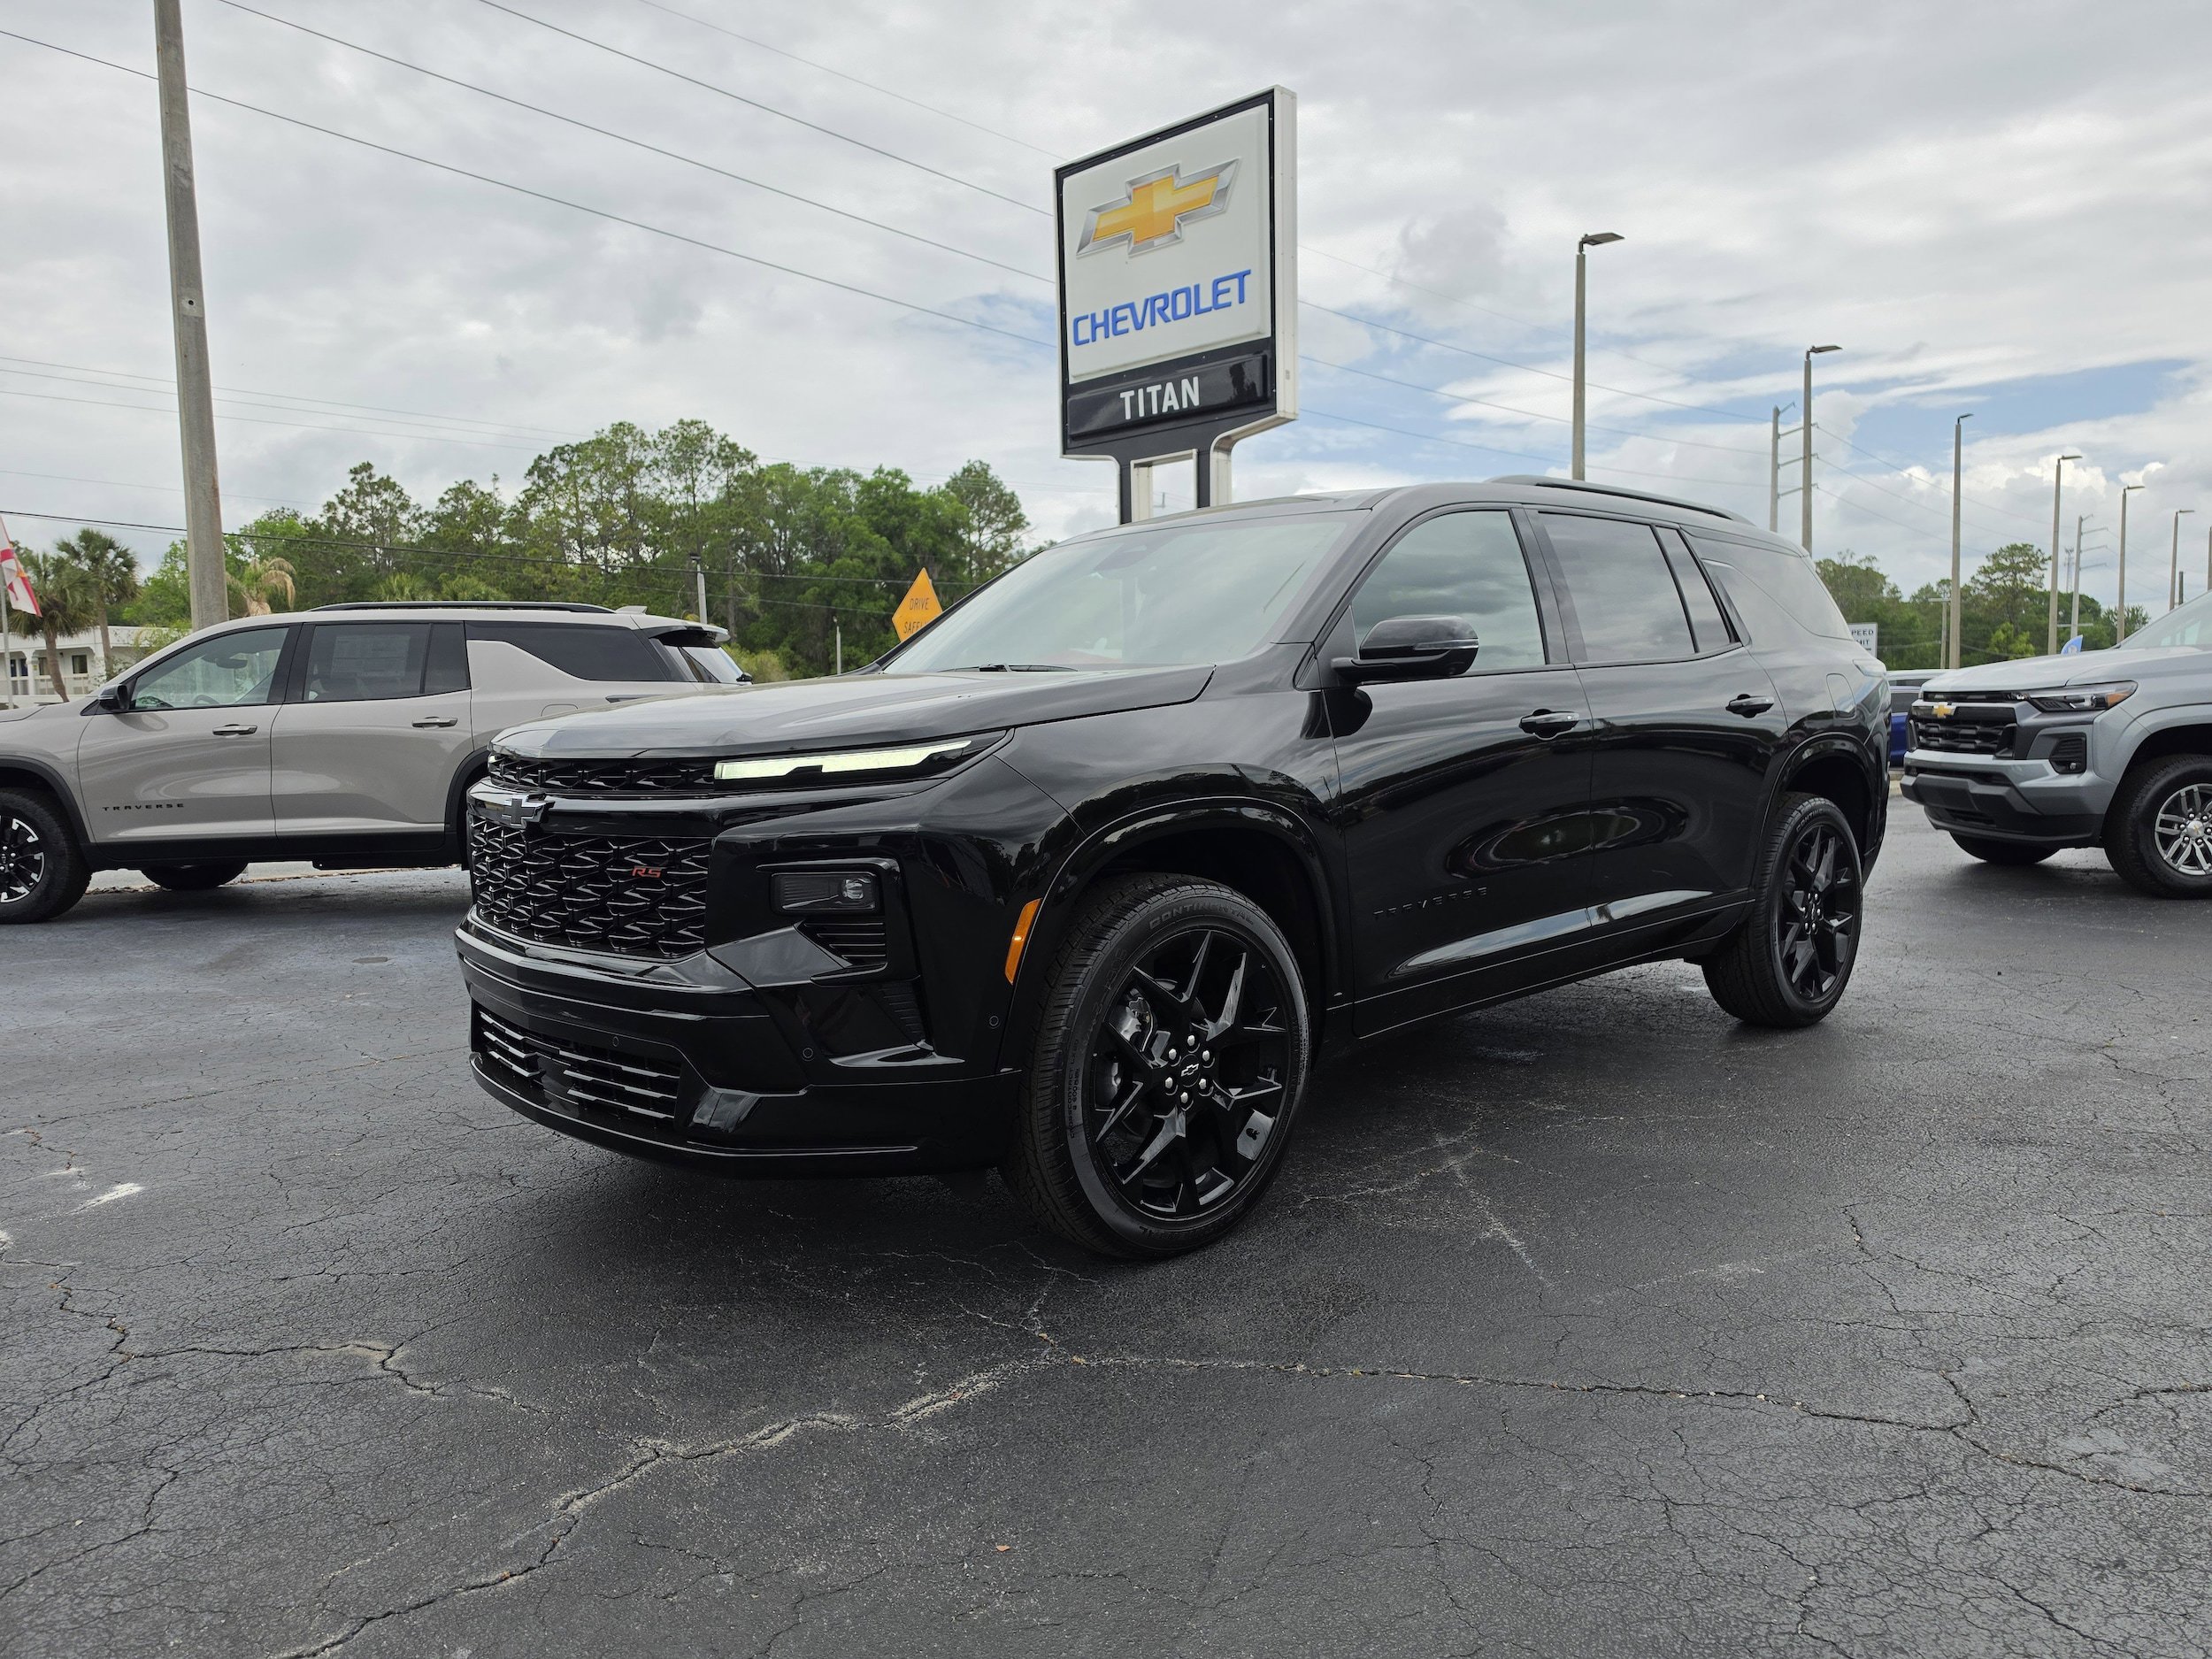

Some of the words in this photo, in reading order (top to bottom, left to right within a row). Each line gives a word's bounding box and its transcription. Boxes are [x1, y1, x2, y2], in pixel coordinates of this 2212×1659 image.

[1072, 269, 1251, 346] CHEVROLET
[1119, 376, 1200, 420] TITAN
[910, 597, 929, 611] DRIVE
[102, 803, 184, 811] TRAVERSE
[632, 866, 662, 878] RS
